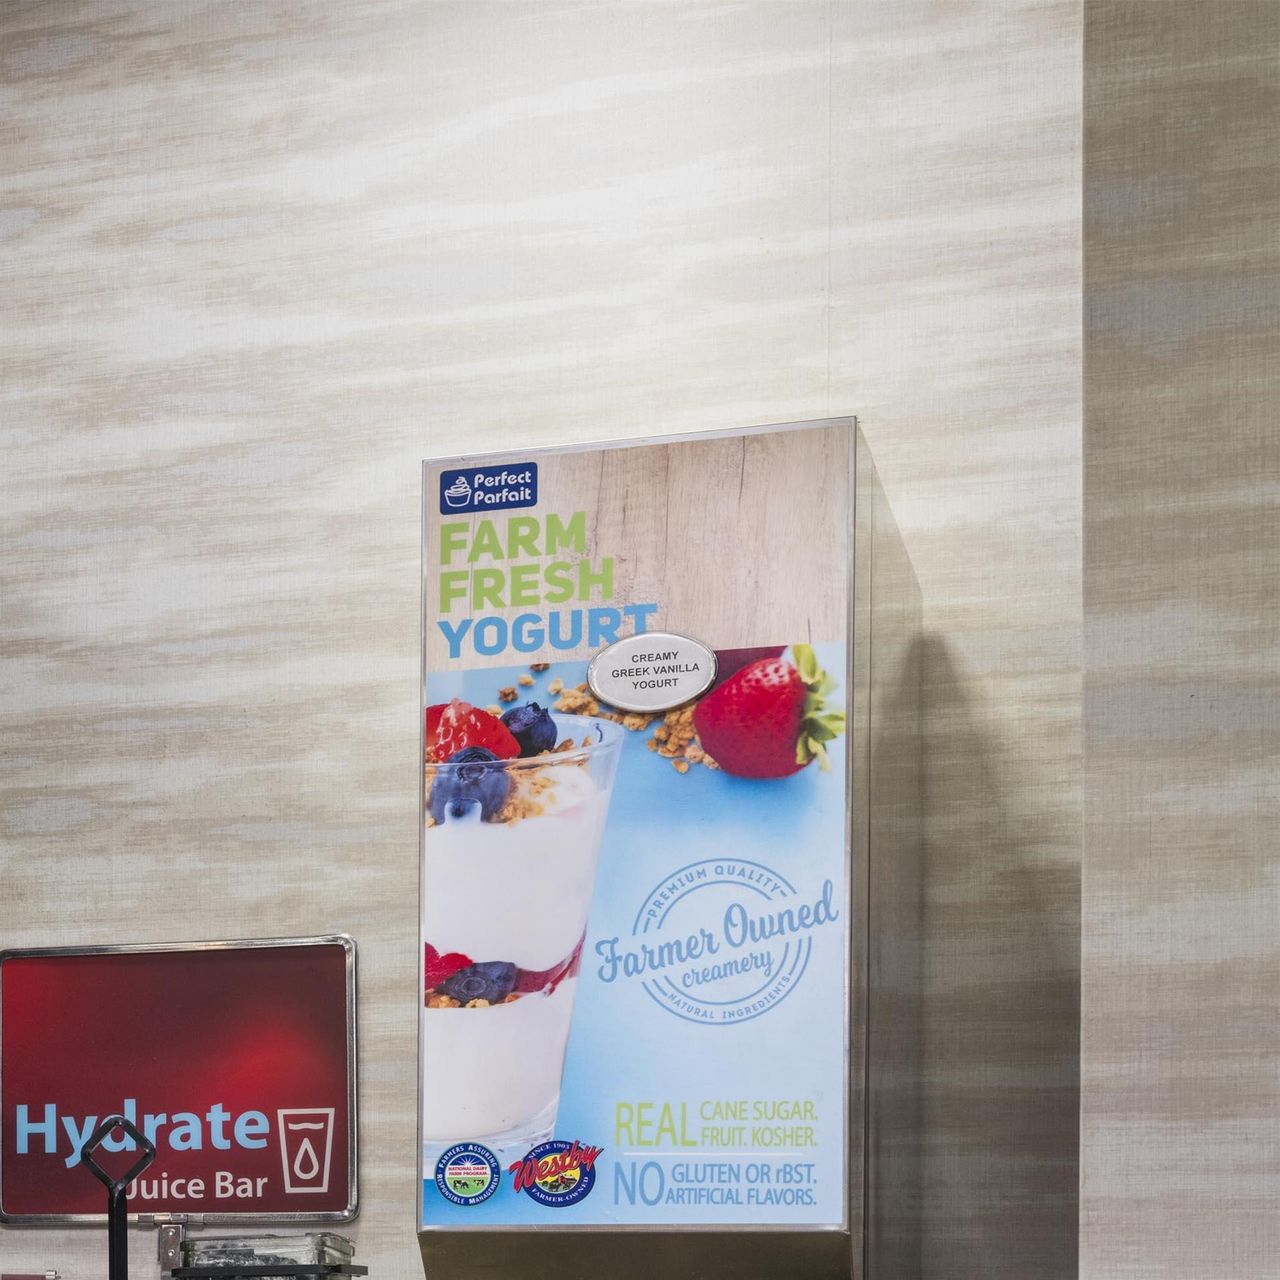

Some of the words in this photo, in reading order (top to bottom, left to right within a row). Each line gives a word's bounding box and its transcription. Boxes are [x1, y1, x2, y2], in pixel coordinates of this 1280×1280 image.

[473, 470, 532, 489] Perfect
[473, 487, 532, 506] Parfait
[440, 511, 586, 565] FARM
[440, 556, 615, 613] FRESH
[437, 603, 658, 659] YOGURT
[611, 666, 651, 679] GREEK
[652, 663, 700, 676] VANILLA
[631, 651, 680, 664] CREAMY
[632, 677, 679, 690] YOGURT
[647, 867, 708, 918] PREMIUM
[713, 864, 780, 893] QUALITY
[594, 927, 721, 984] Farmer
[723, 879, 840, 949] Owned
[682, 951, 774, 989] creamery
[667, 993, 715, 1019] NATURAL
[722, 975, 791, 1019] INGREDIENTS
[15, 1098, 271, 1169] Hydrate
[614, 1101, 698, 1147] REAL
[699, 1100, 749, 1121] CANE
[752, 1100, 818, 1121] SUGAR.
[700, 1126, 748, 1147] FRUIT.
[751, 1126, 818, 1147] KOSHER.
[508, 1140, 604, 1193] Westby
[528, 1143, 552, 1159] SINCE
[126, 1172, 206, 1200] Juice
[214, 1171, 268, 1199] Bar
[531, 1176, 589, 1202] FARMER-OWNED
[613, 1160, 665, 1206] NO
[671, 1163, 741, 1184] GLUTEN
[745, 1163, 771, 1184] OR
[775, 1163, 818, 1184] rBST.
[665, 1187, 744, 1206] ARTIFICIAL
[747, 1188, 818, 1206] FLAVORS.
